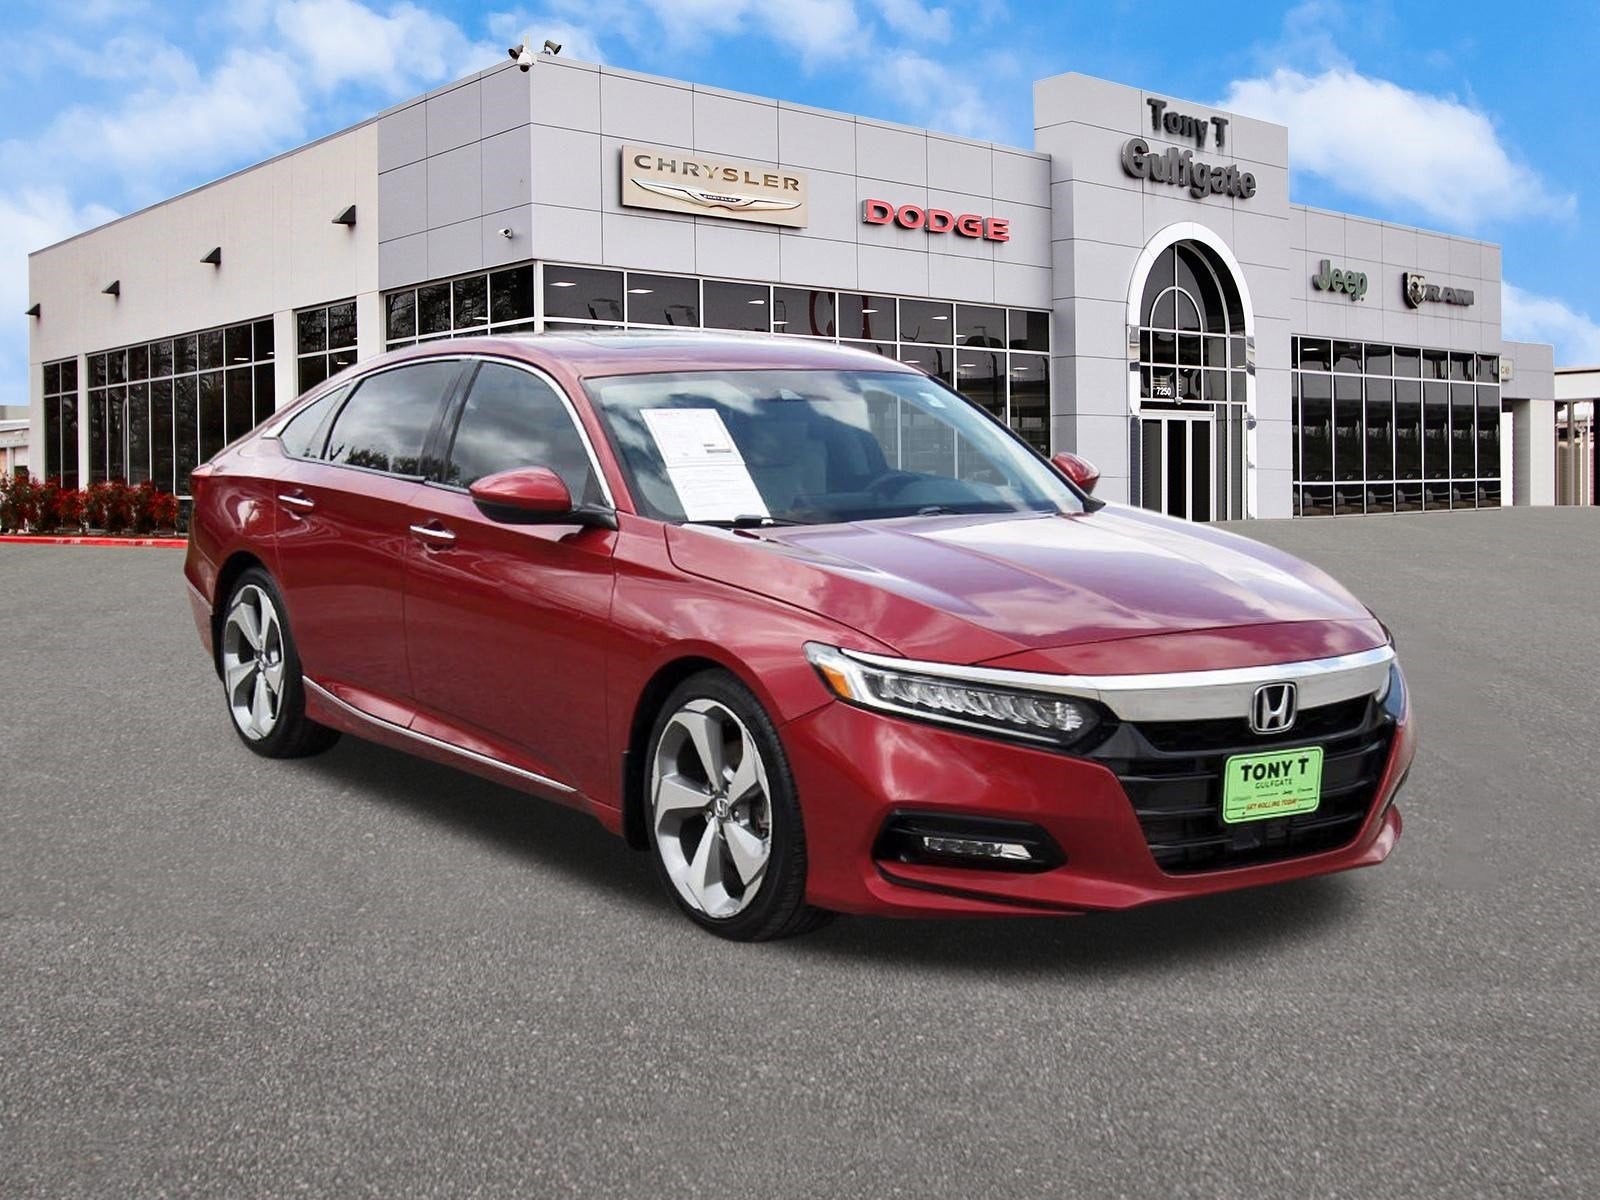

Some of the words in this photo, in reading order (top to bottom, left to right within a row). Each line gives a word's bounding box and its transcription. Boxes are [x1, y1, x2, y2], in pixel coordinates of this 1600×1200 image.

[1147, 98, 1208, 147] Tony
[1211, 116, 1229, 147] T
[633, 154, 800, 192] CHRYSLER
[1121, 137, 1256, 199] Gulfgate
[862, 198, 1010, 242] DODGE
[1312, 259, 1368, 301] Jeep
[1425, 284, 1475, 306] RAM
[1156, 387, 1171, 396] 7250
[1241, 760, 1293, 782] TONY
[1298, 758, 1310, 775] T
